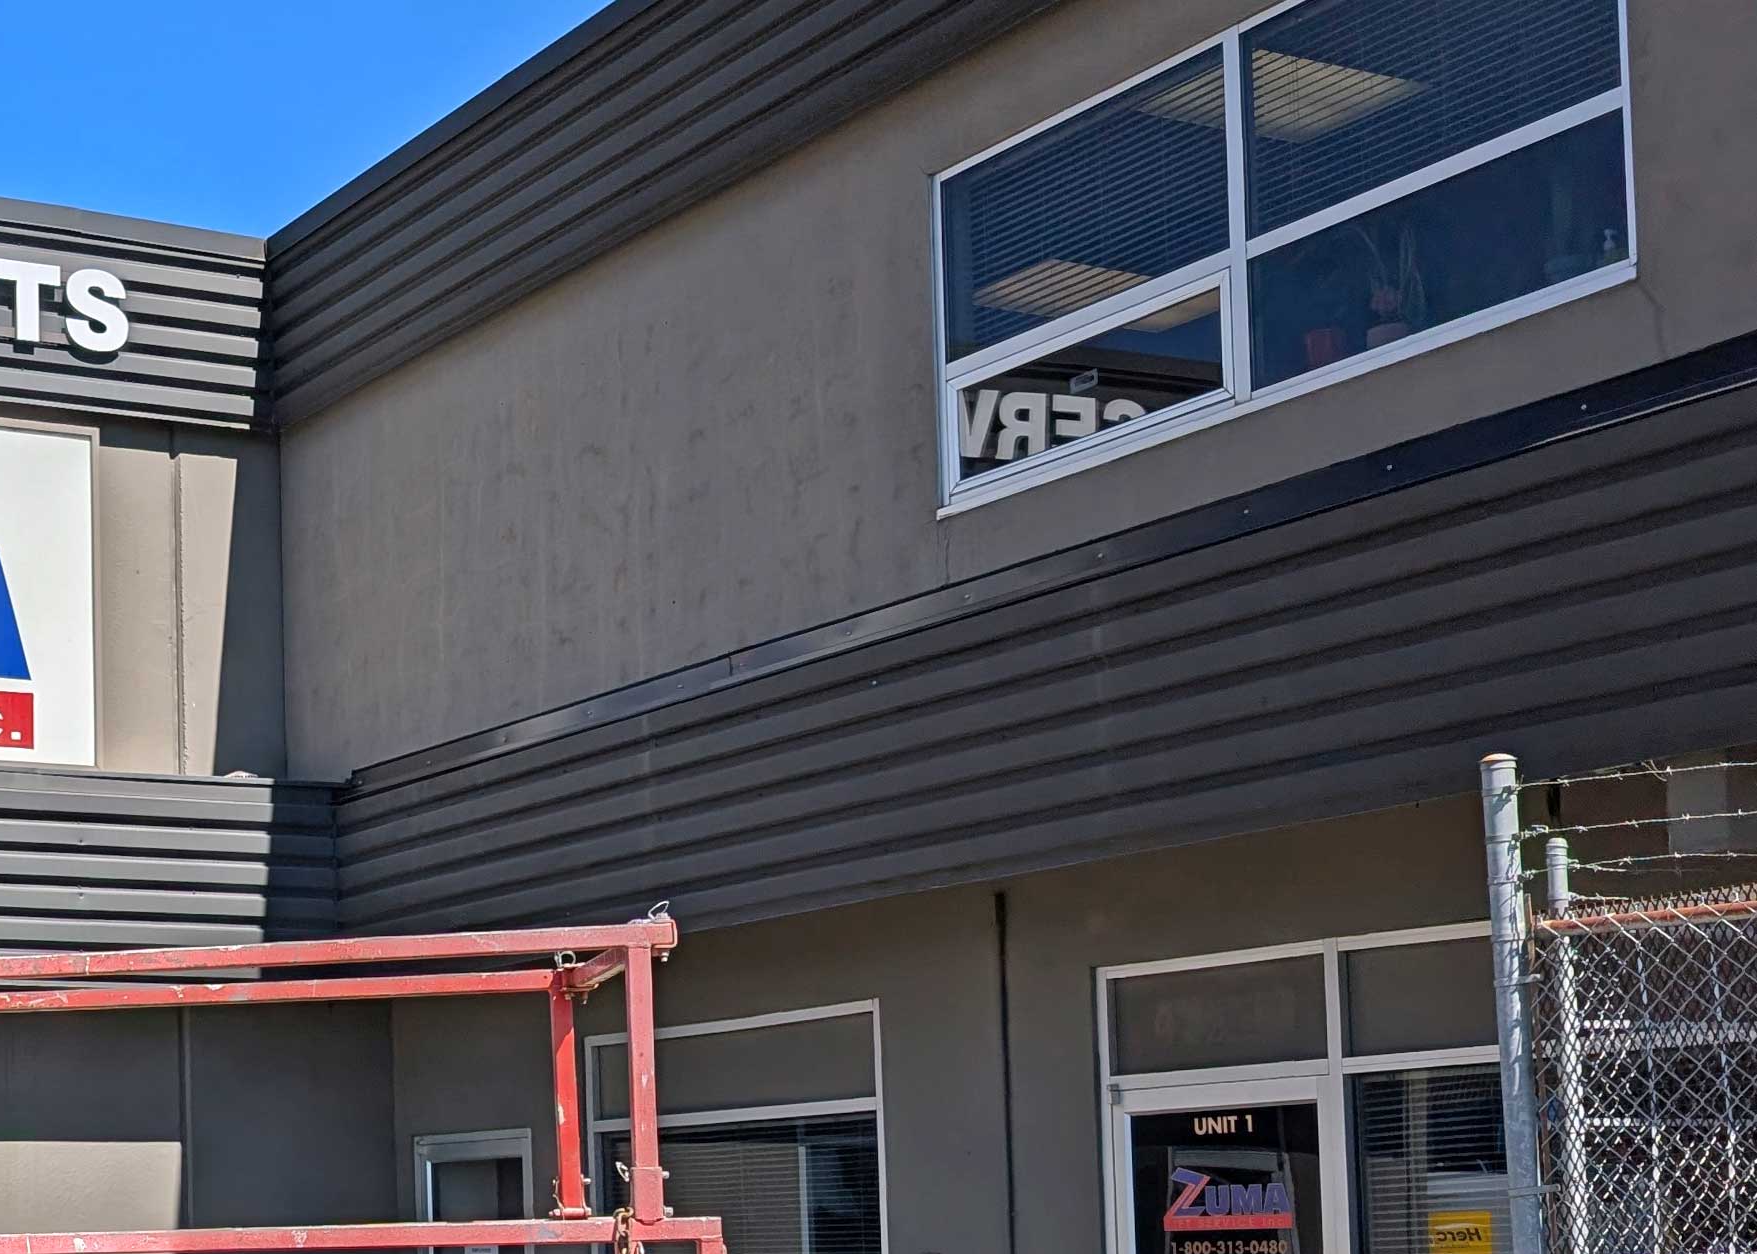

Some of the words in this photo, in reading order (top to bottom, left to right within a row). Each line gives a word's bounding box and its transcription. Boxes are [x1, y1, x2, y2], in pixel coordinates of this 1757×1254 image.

[1194, 1115, 1238, 1136] UNIT
[1244, 1114, 1253, 1133] 1
[1165, 1167, 1291, 1217] ZUMA
